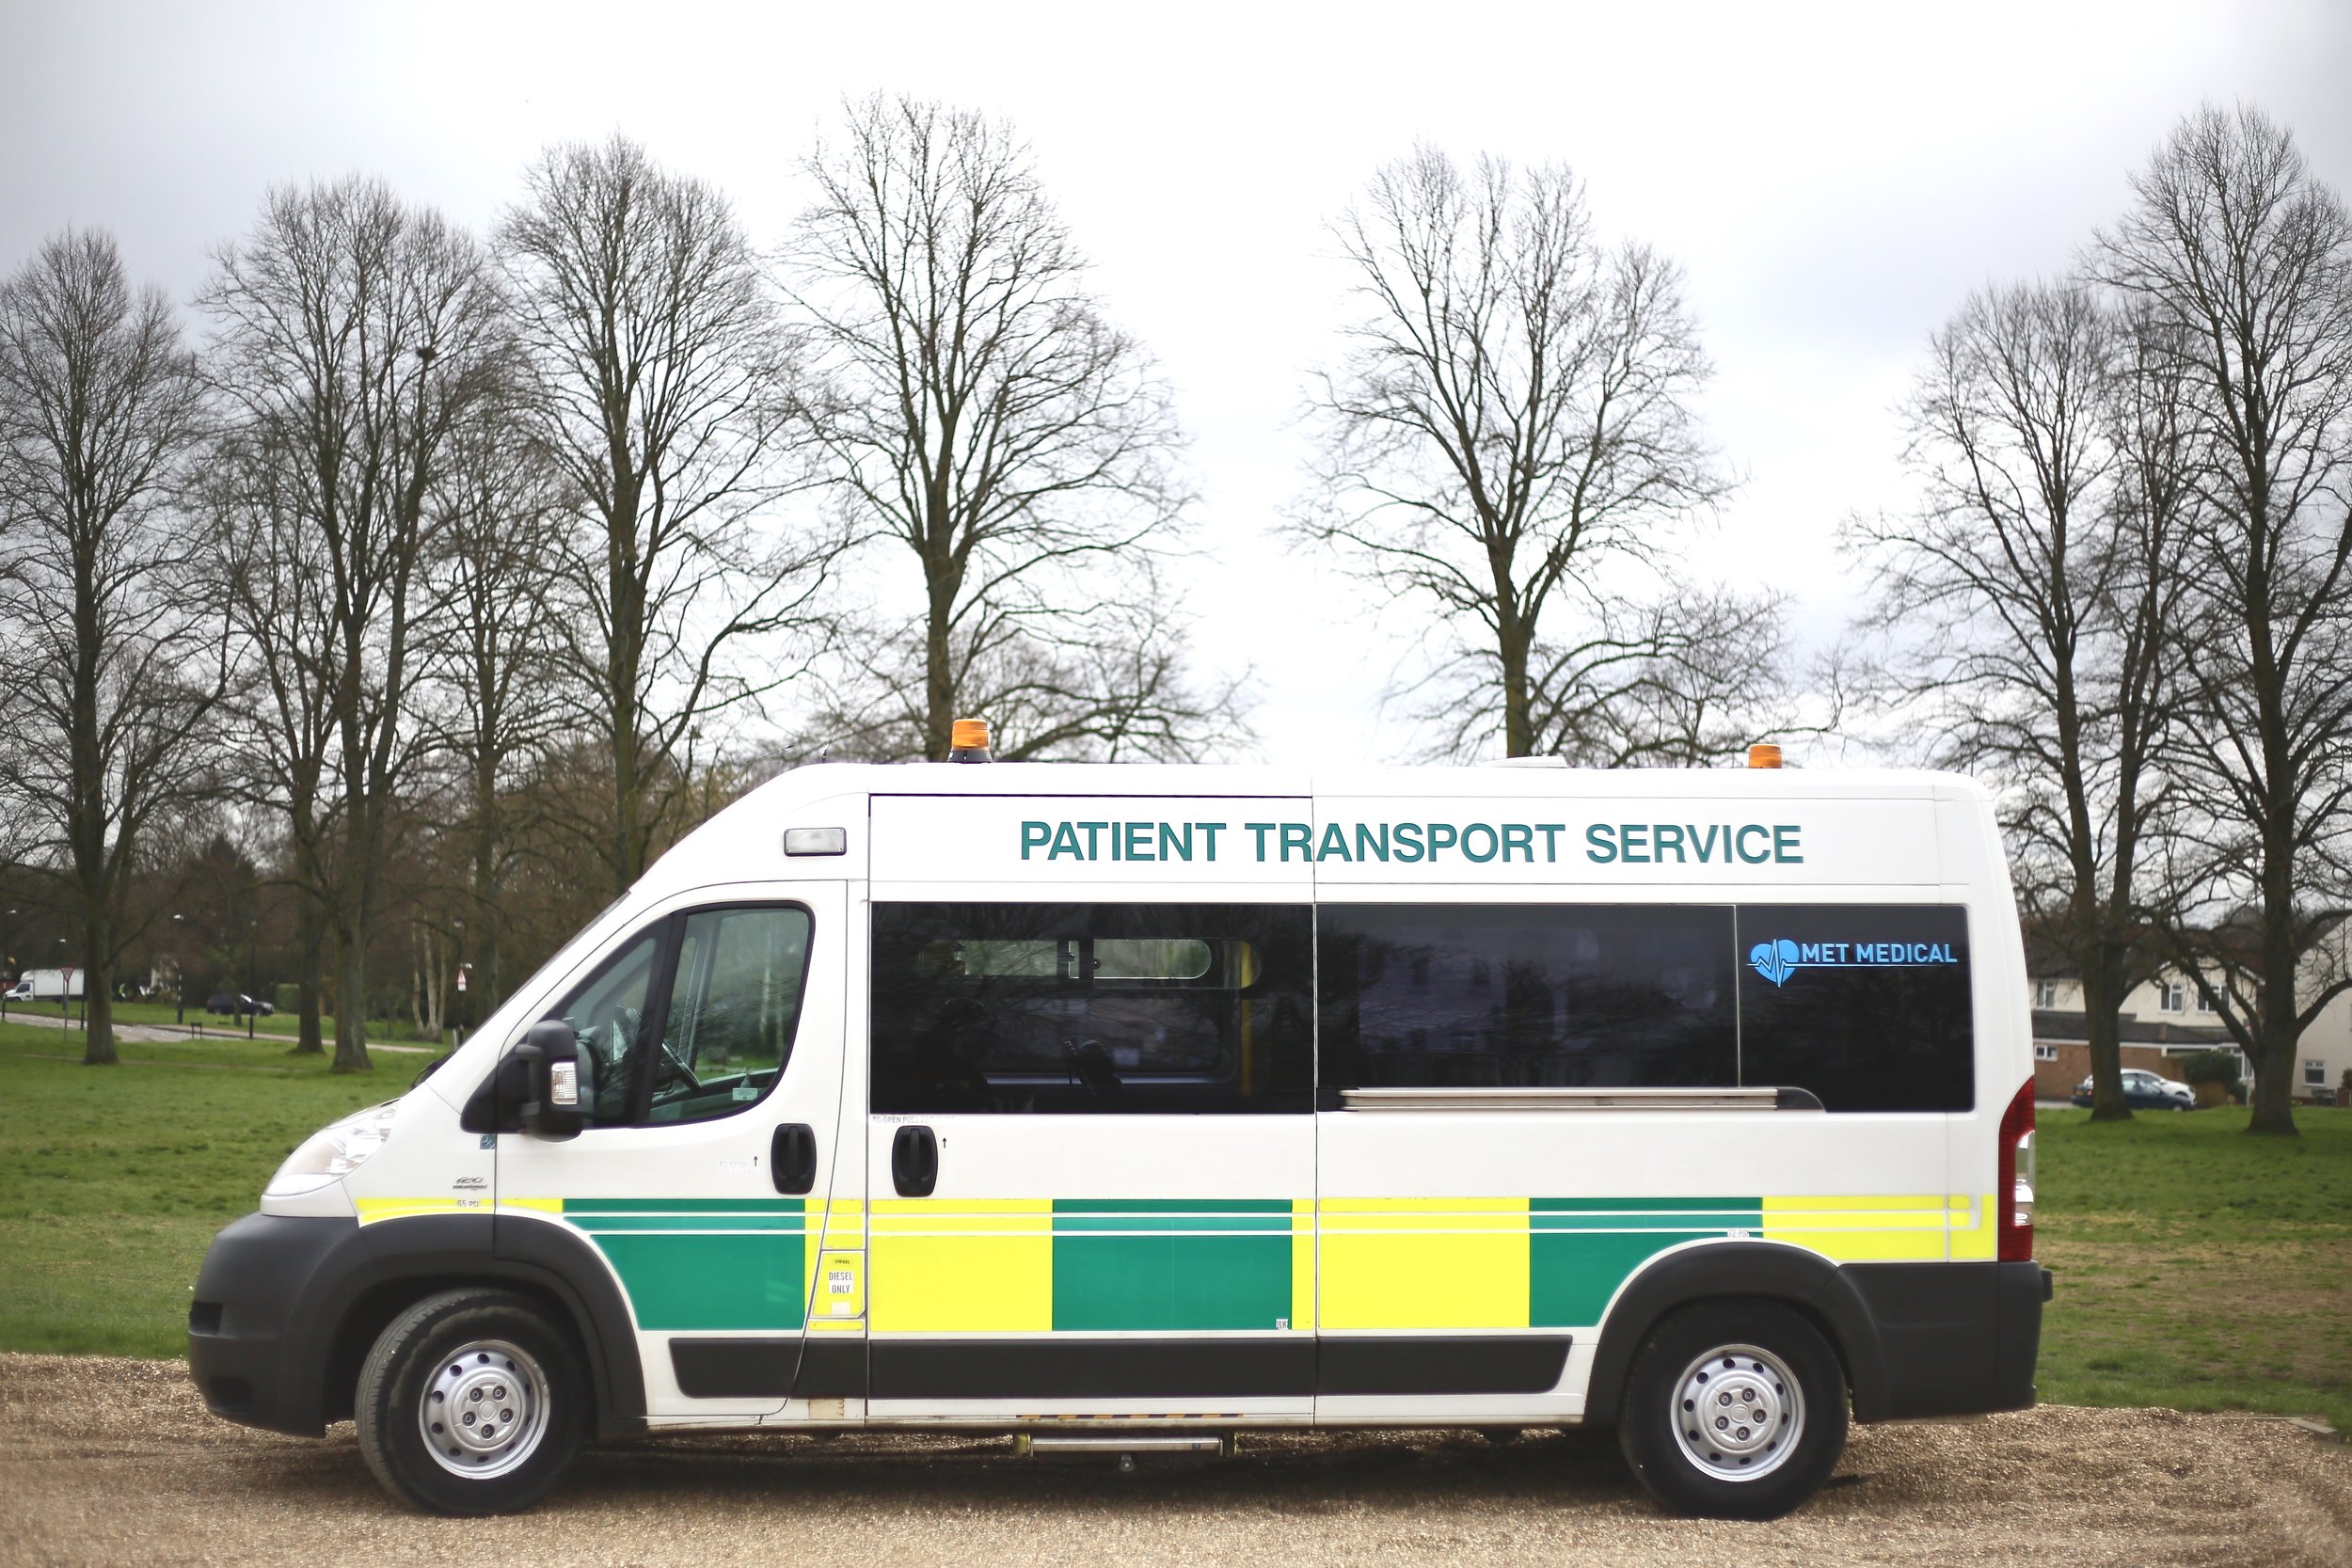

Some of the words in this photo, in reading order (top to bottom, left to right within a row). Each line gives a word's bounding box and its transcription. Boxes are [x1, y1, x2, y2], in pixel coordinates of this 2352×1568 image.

[1021, 820, 1227, 862] PATIENT
[1244, 822, 1566, 863] TRANSPORT
[1585, 824, 1804, 864] SERVICE
[1802, 943, 1850, 962] MET
[1855, 943, 1958, 963] MEDICAL
[882, 1116, 901, 1124] OPEN
[828, 1272, 853, 1281] DIESEL
[832, 1284, 850, 1294] ONLY
